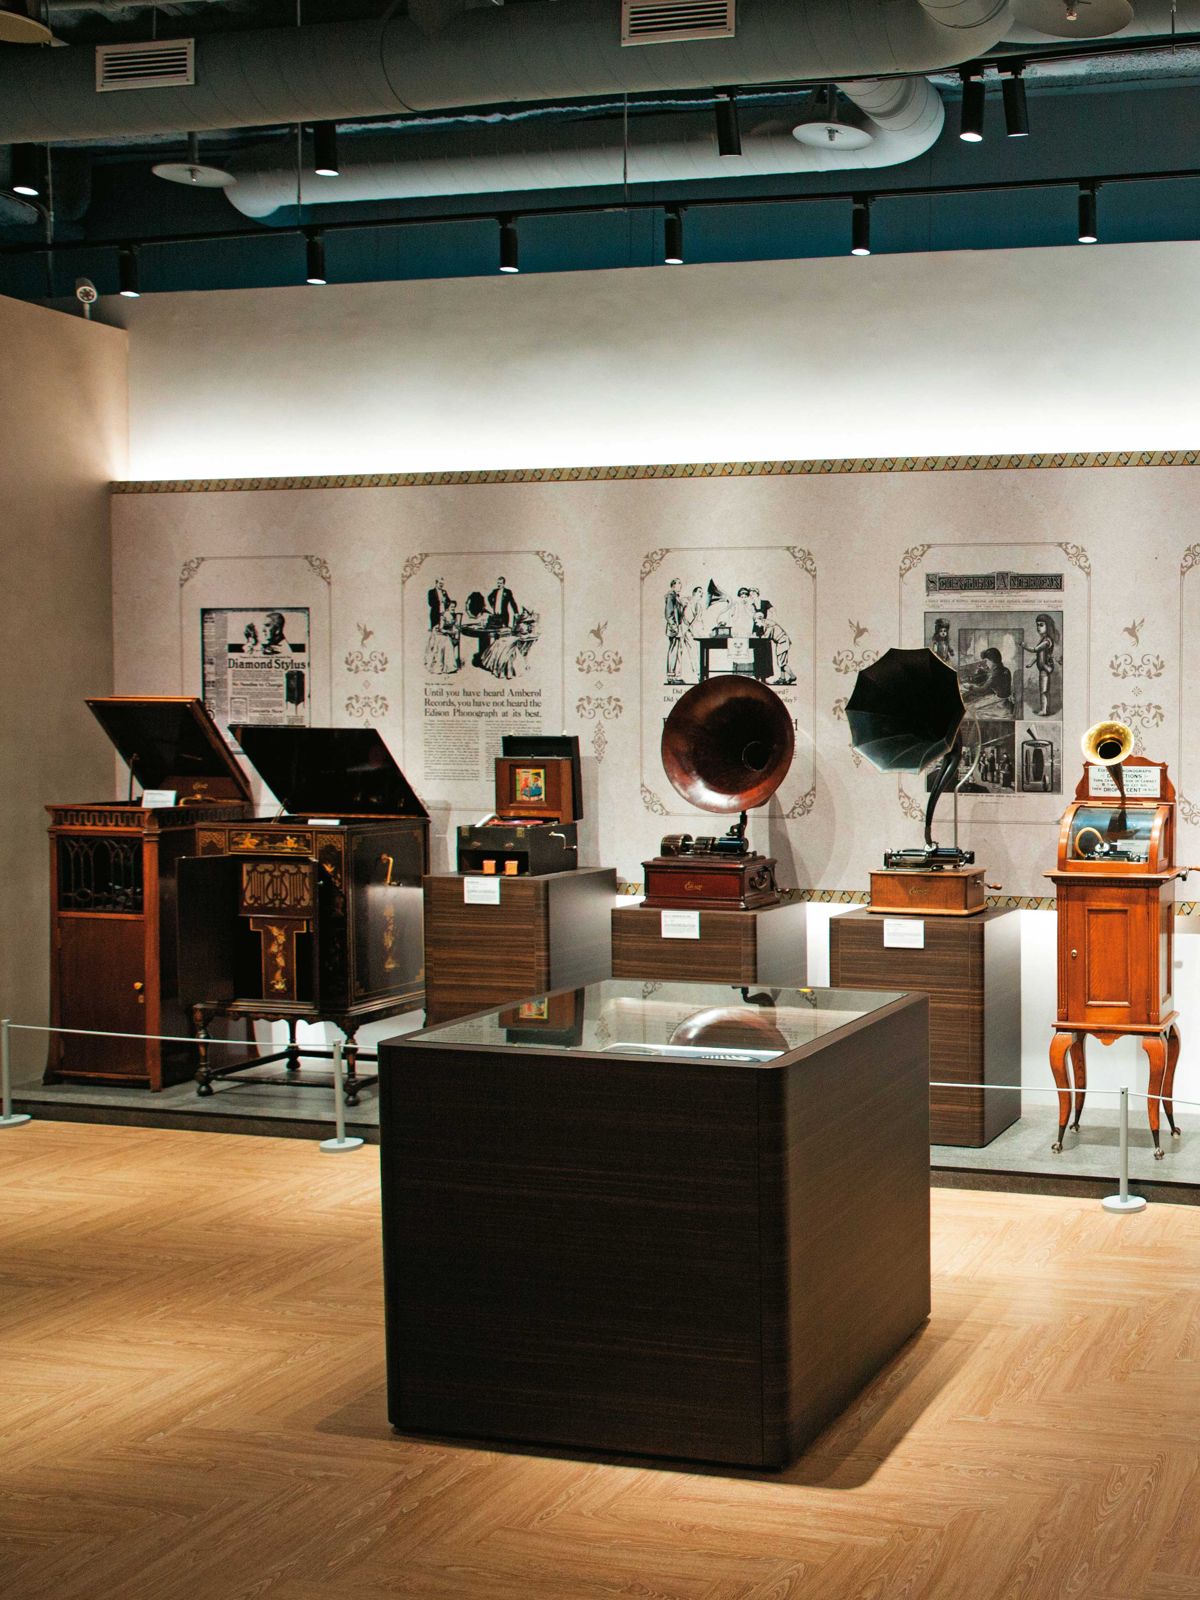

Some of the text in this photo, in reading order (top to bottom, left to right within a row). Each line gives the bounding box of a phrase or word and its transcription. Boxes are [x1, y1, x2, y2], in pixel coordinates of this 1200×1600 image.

[228, 658, 306, 670] Diamond Stylus
[424, 688, 542, 698] Until you have heard Amberol
[424, 698, 542, 709] Records, you have not heard the
[424, 708, 450, 717] Edison
[453, 708, 498, 719] Phonograph
[512, 709, 521, 717] its
[525, 709, 542, 717] best.
